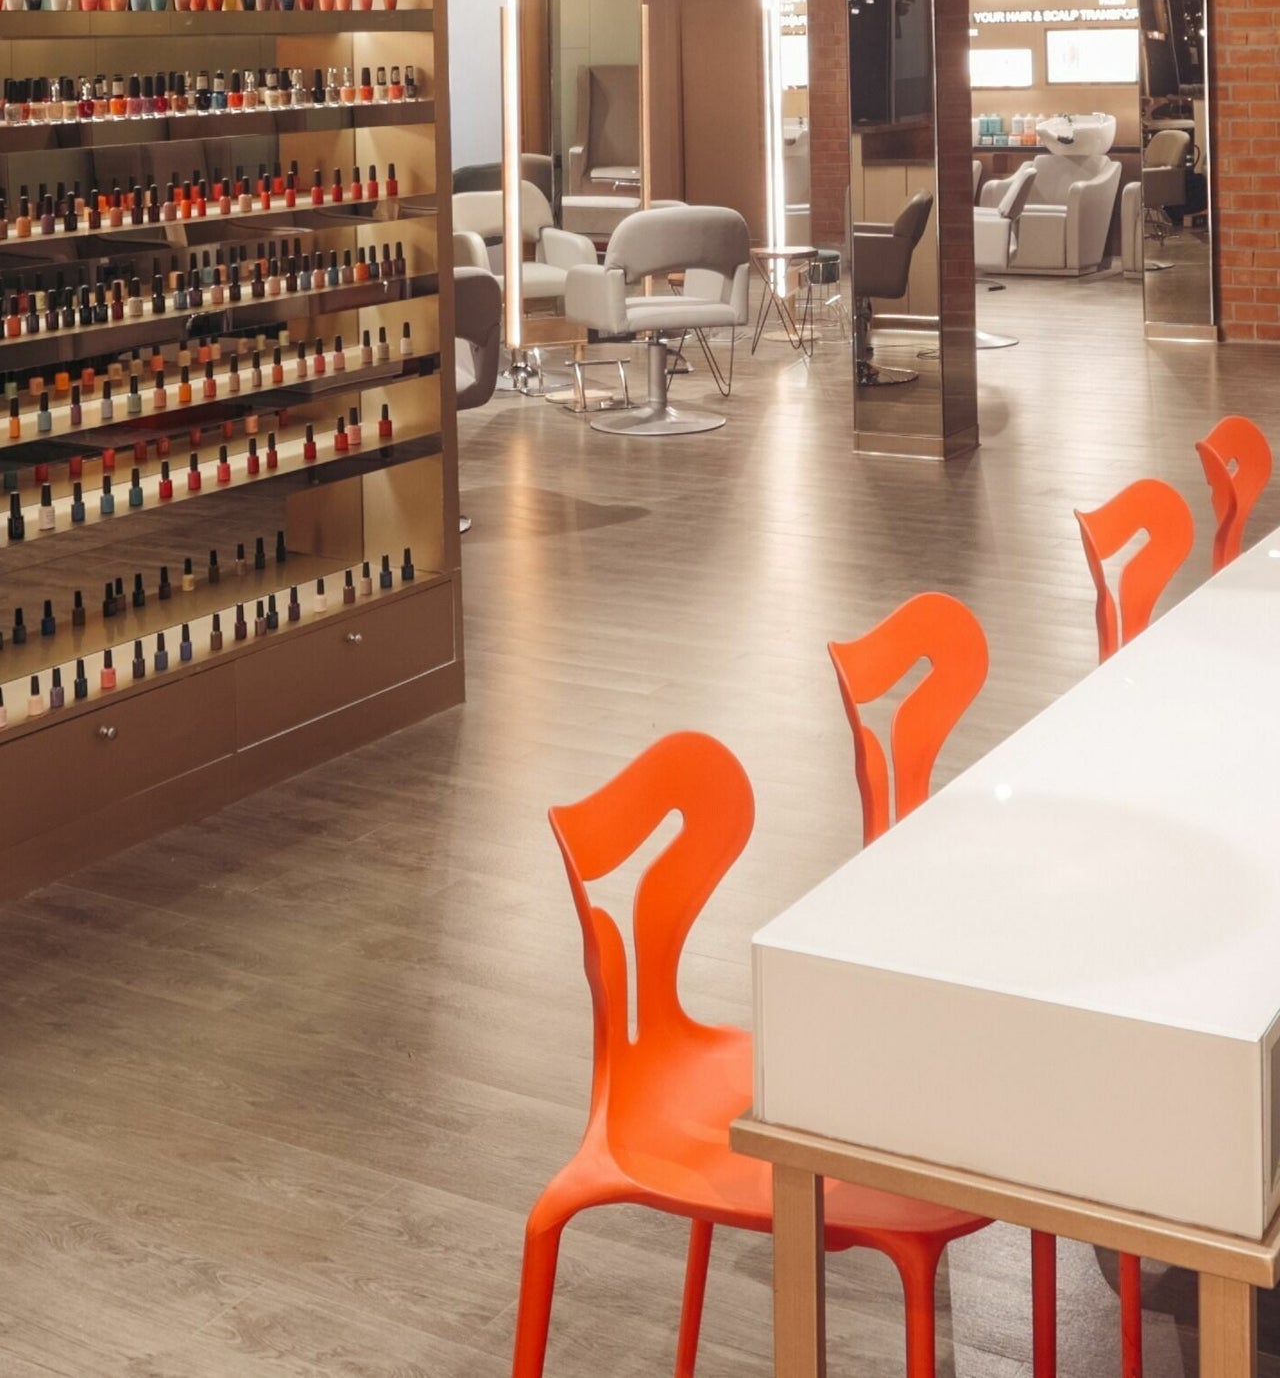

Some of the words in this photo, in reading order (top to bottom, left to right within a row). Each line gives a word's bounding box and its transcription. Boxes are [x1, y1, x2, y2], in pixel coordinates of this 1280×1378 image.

[973, 11, 1005, 23] YOUR
[1006, 10, 1032, 22] HAIR
[1033, 10, 1042, 21] &
[1043, 9, 1079, 22] SCALP
